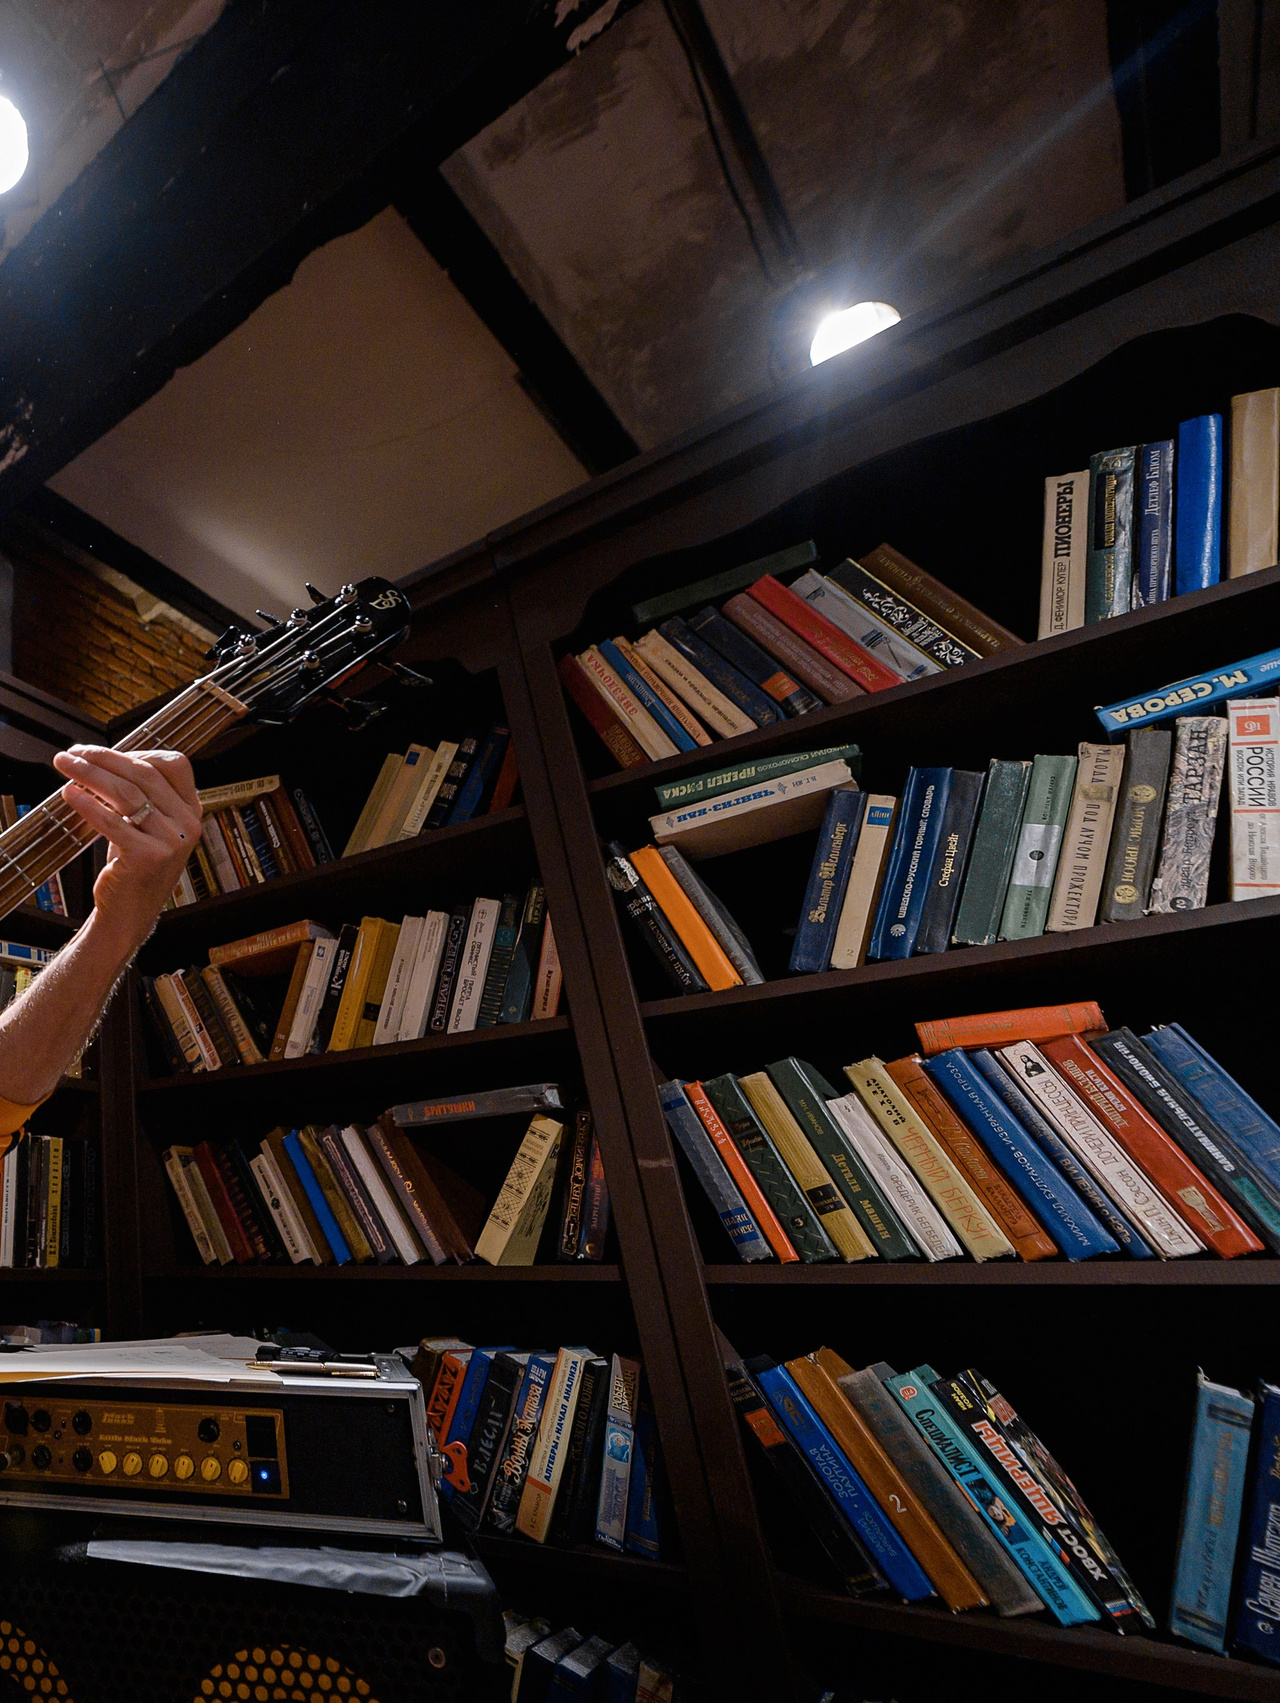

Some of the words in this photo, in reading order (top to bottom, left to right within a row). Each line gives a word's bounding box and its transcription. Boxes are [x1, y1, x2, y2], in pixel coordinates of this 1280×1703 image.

[1144, 450, 1161, 479] БЛЮМ
[1051, 479, 1076, 559] ПИОНЕРЫ
[1056, 561, 1067, 584] КУПЕР
[584, 649, 638, 720] ЗВЕЗДОЧКА
[1108, 676, 1214, 727] СЕРОВА
[705, 765, 757, 789] ПРЕДЕЛ
[756, 752, 809, 772] СКОМОРОХОВ
[1177, 724, 1214, 806] ТАРЗАН
[1235, 749, 1244, 772] ВОСТОК
[1236, 773, 1245, 785] ИЛИ
[1245, 747, 1264, 806] РОССИИ
[1265, 747, 1274, 776] ИСТОРИЯ
[662, 780, 704, 800] РИСКА
[920, 784, 935, 818] СЛОВАРЬ
[1236, 786, 1245, 805] ЗАПАД
[913, 818, 928, 849] ГОРНЫЙ
[1083, 802, 1099, 825] ПОД
[1124, 803, 1148, 843] МОРИС
[942, 830, 963, 858] Цвейг
[1075, 827, 1094, 860] ЛУЧОМ
[1119, 845, 1140, 883] ДРЮОН
[897, 849, 921, 919] ШВЕДСКО-РУССКИЙ
[936, 855, 957, 887] Стефан
[1247, 857, 1256, 879] Второго
[1060, 864, 1087, 928] ПРОЖЕКТОРА
[467, 940, 485, 975] ПЯТНИСТЫЙ
[450, 1006, 463, 1029] ВЫЗОВ
[944, 1060, 971, 1092] ПРОЗА
[1061, 1055, 1096, 1094] БАЛАШОВ
[1111, 1038, 1161, 1091] БИОЛОГИЯ
[422, 1098, 476, 1118] БРАТУШКИ
[863, 1079, 901, 1127] ЧЕХОВ
[869, 1076, 907, 1123] АНАТОЛИЙ
[967, 1090, 1013, 1146] ИЗБРАННАЯ
[1036, 1075, 1089, 1135] ПРИНЦЕССЫ
[1088, 1088, 1128, 1132] ДМИТРИЙ
[1078, 1124, 1119, 1169] ДОЧЕРИ
[1155, 1086, 1235, 1175] ЗАНИМАТЕЛЬНАЯ
[830, 1149, 864, 1194] Детали
[859, 1196, 892, 1240] машин
[887, 1171, 923, 1216] ФРЕДЕРИК
[896, 1123, 952, 1188] ЧЕРНЫЙ
[937, 1181, 995, 1248] БЕРКУТ
[1011, 1148, 1056, 1202] БУЛГАКОВ
[1113, 1167, 1151, 1208] Сэссон
[1051, 1200, 1091, 1247] МИХАИЛ
[1151, 1213, 1187, 1252] Джин
[560, 1359, 579, 1402] АНАЛИЗА
[577, 1372, 596, 1411] ЛЮБВИ
[606, 1374, 629, 1410] РОБЕРТ
[614, 1369, 641, 1414] ДЖОРДАН
[553, 1404, 569, 1435] НАЧАЛ
[498, 1430, 535, 1482] Волны
[541, 1440, 559, 1481] АЛГЕБРЫ
[807, 1446, 849, 1500] ЗОЛОТАЯ
[815, 1442, 859, 1498] ПАУТИНА
[970, 1414, 1070, 1533] ЯЩЕРИЦЫ
[888, 1491, 907, 1515] 2
[1055, 1522, 1108, 1585] ХВОСТ
